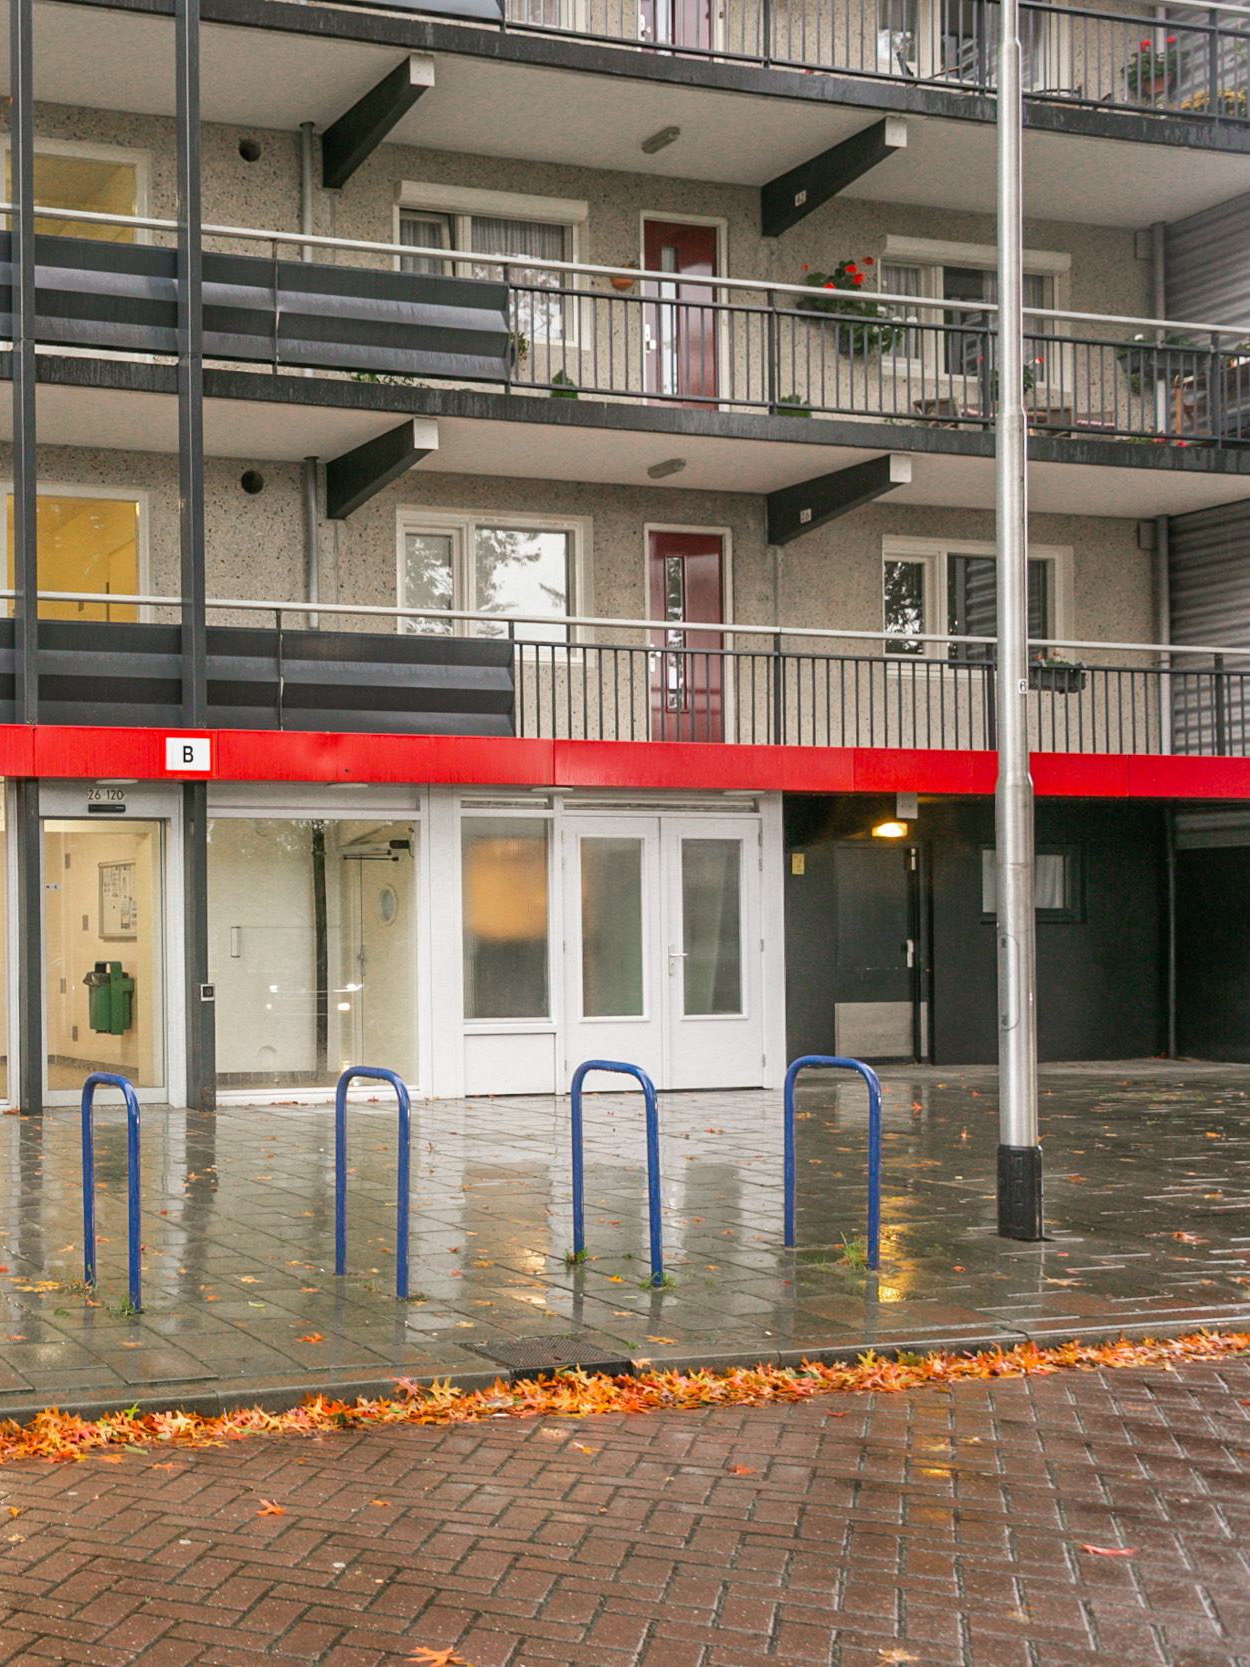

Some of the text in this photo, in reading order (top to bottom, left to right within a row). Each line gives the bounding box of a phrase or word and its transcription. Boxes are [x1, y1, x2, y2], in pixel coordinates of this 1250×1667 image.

[183, 745, 194, 763] B
[88, 789, 123, 800] 26 120
